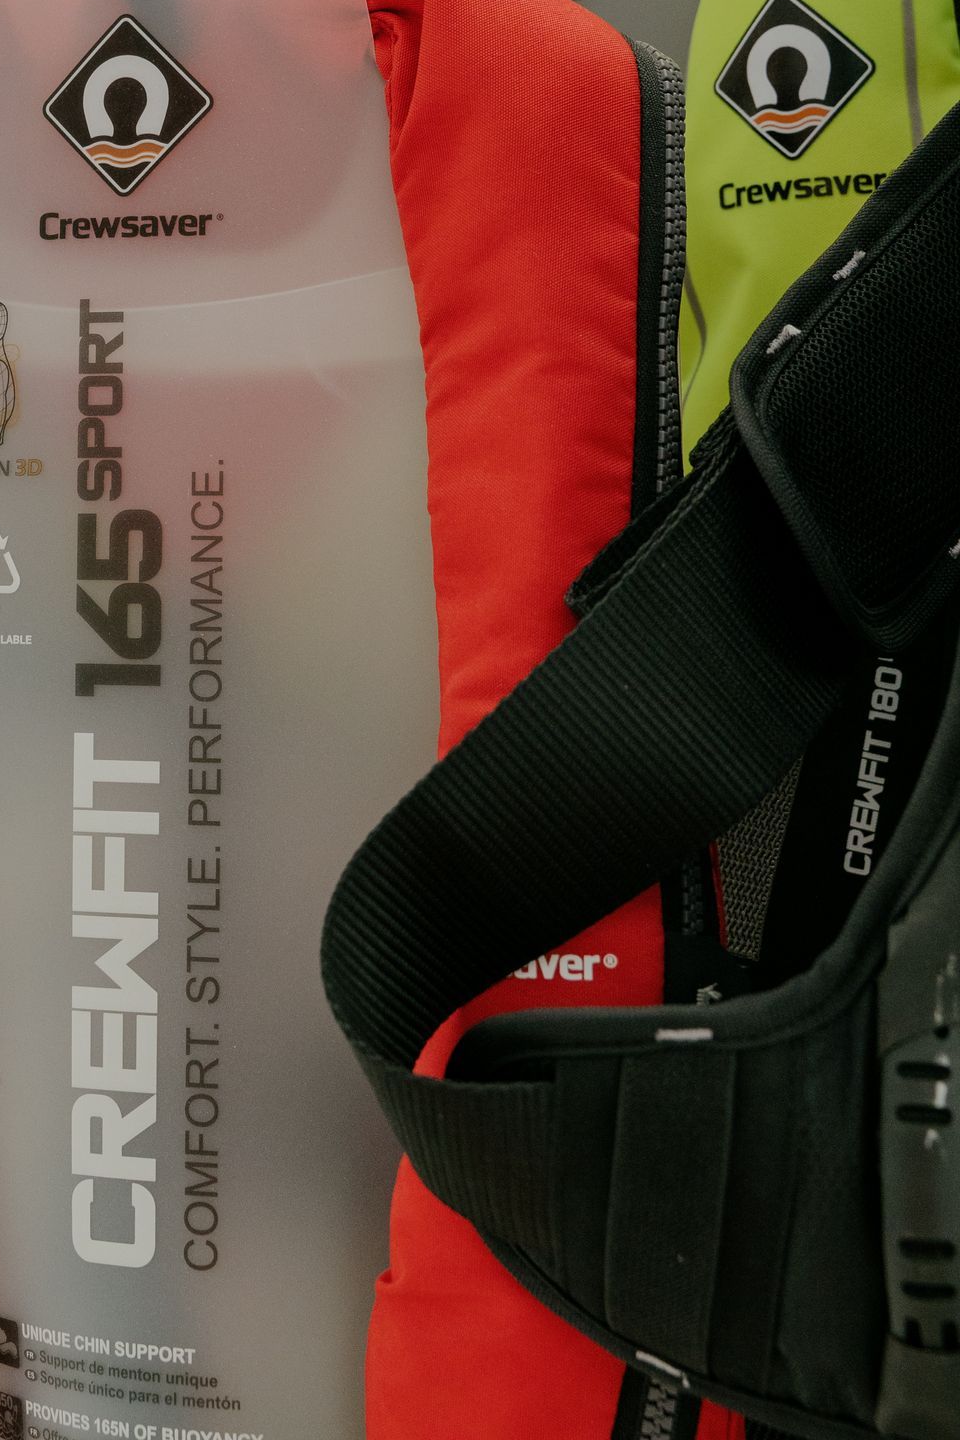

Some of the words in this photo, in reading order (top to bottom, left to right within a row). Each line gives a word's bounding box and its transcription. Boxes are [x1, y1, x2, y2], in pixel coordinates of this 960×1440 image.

[719, 172, 888, 210] Crewsaver
[15, 458, 43, 477] 3D
[76, 299, 125, 502] SPORT
[75, 508, 163, 697] 165
[187, 459, 224, 827] PERFORMANCE.
[843, 729, 892, 877] CREWFIT
[868, 665, 903, 722] 180
[71, 732, 161, 1268] CREWFIT
[186, 846, 221, 1004] STYLE.
[183, 1023, 220, 1271] COMFORT.
[21, 1322, 71, 1348] UNIQUE
[74, 1334, 110, 1356] CHIN
[114, 1340, 196, 1365] SUPPORT
[25, 1350, 35, 1360] FR
[39, 1350, 86, 1373] Support
[88, 1360, 105, 1375] de
[108, 1365, 161, 1384] menton
[166, 1371, 218, 1390] unique
[25, 1400, 91, 1431] PROVIDES
[94, 1417, 130, 1439] 165N
[134, 1423, 157, 1440] OF
[40, 1370, 86, 1393] Soporte
[88, 1381, 125, 1400] único
[128, 1389, 160, 1404] para
[164, 1392, 177, 1407] el
[182, 1395, 242, 1411] mentón
